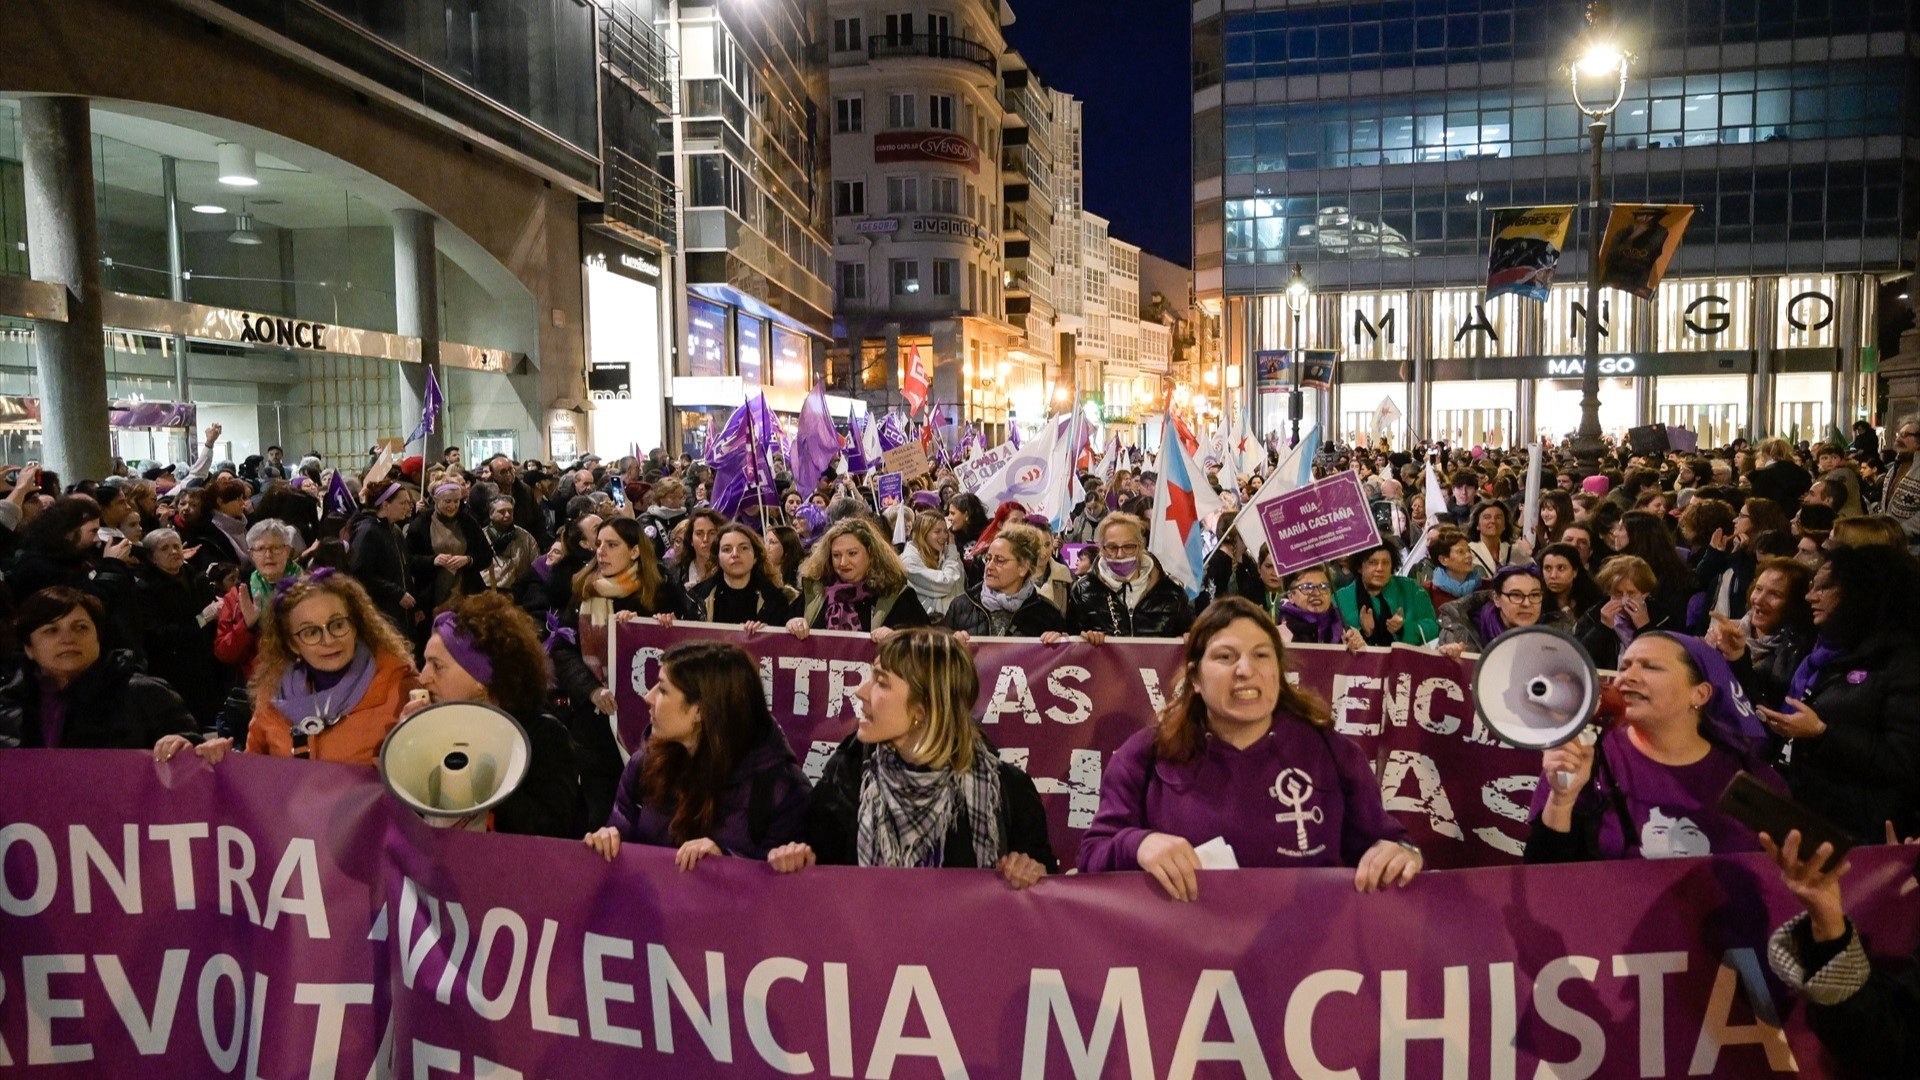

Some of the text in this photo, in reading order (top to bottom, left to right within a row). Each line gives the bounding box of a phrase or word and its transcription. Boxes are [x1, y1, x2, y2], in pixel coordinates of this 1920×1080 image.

[926, 141, 970, 158] SVENSON
[255, 317, 326, 350] ONCE
[1548, 357, 1635, 375] MAGO
[1299, 502, 1317, 515] RÚA
[1278, 520, 1308, 540] MARÍA
[1308, 506, 1355, 529] CASTAÑA
[398, 876, 970, 1080] VIOLENCIA
[1020, 949, 1798, 1080] MACHISTA
